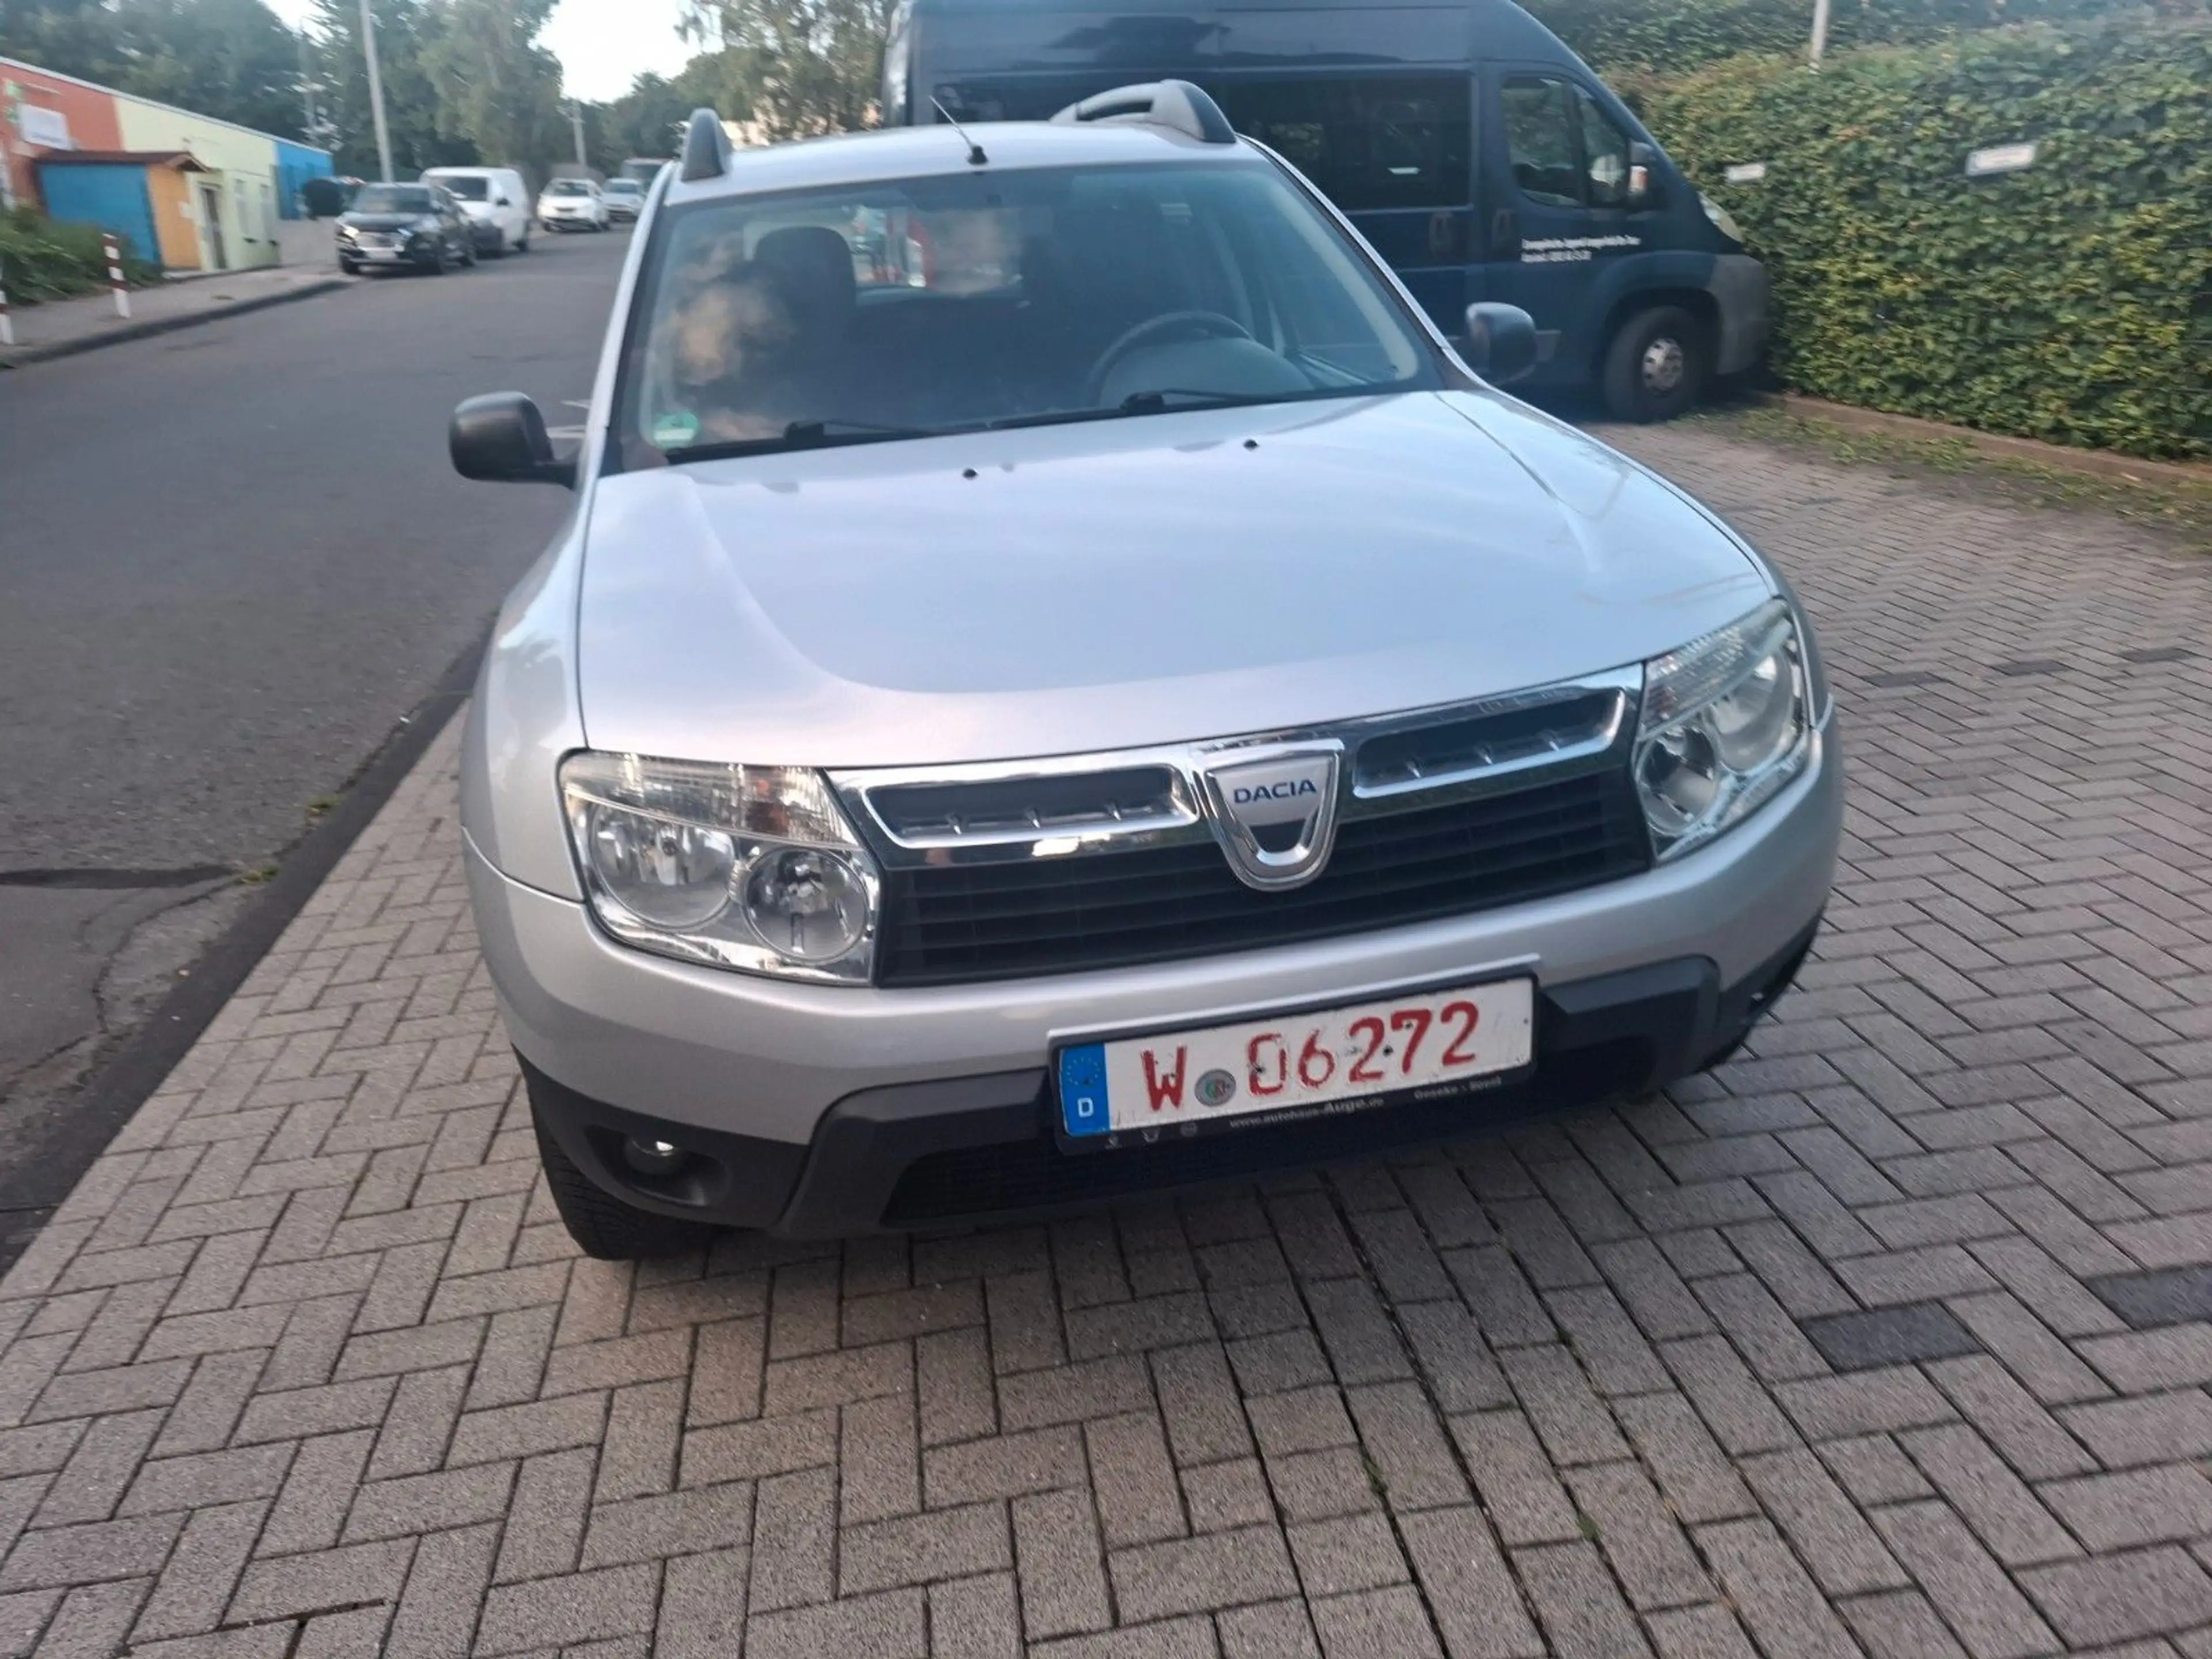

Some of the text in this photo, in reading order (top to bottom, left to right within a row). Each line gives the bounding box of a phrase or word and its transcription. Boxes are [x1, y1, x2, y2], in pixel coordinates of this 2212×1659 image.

[1233, 779, 1317, 804] DACIA
[1077, 1001, 1479, 1118] D W 06272
